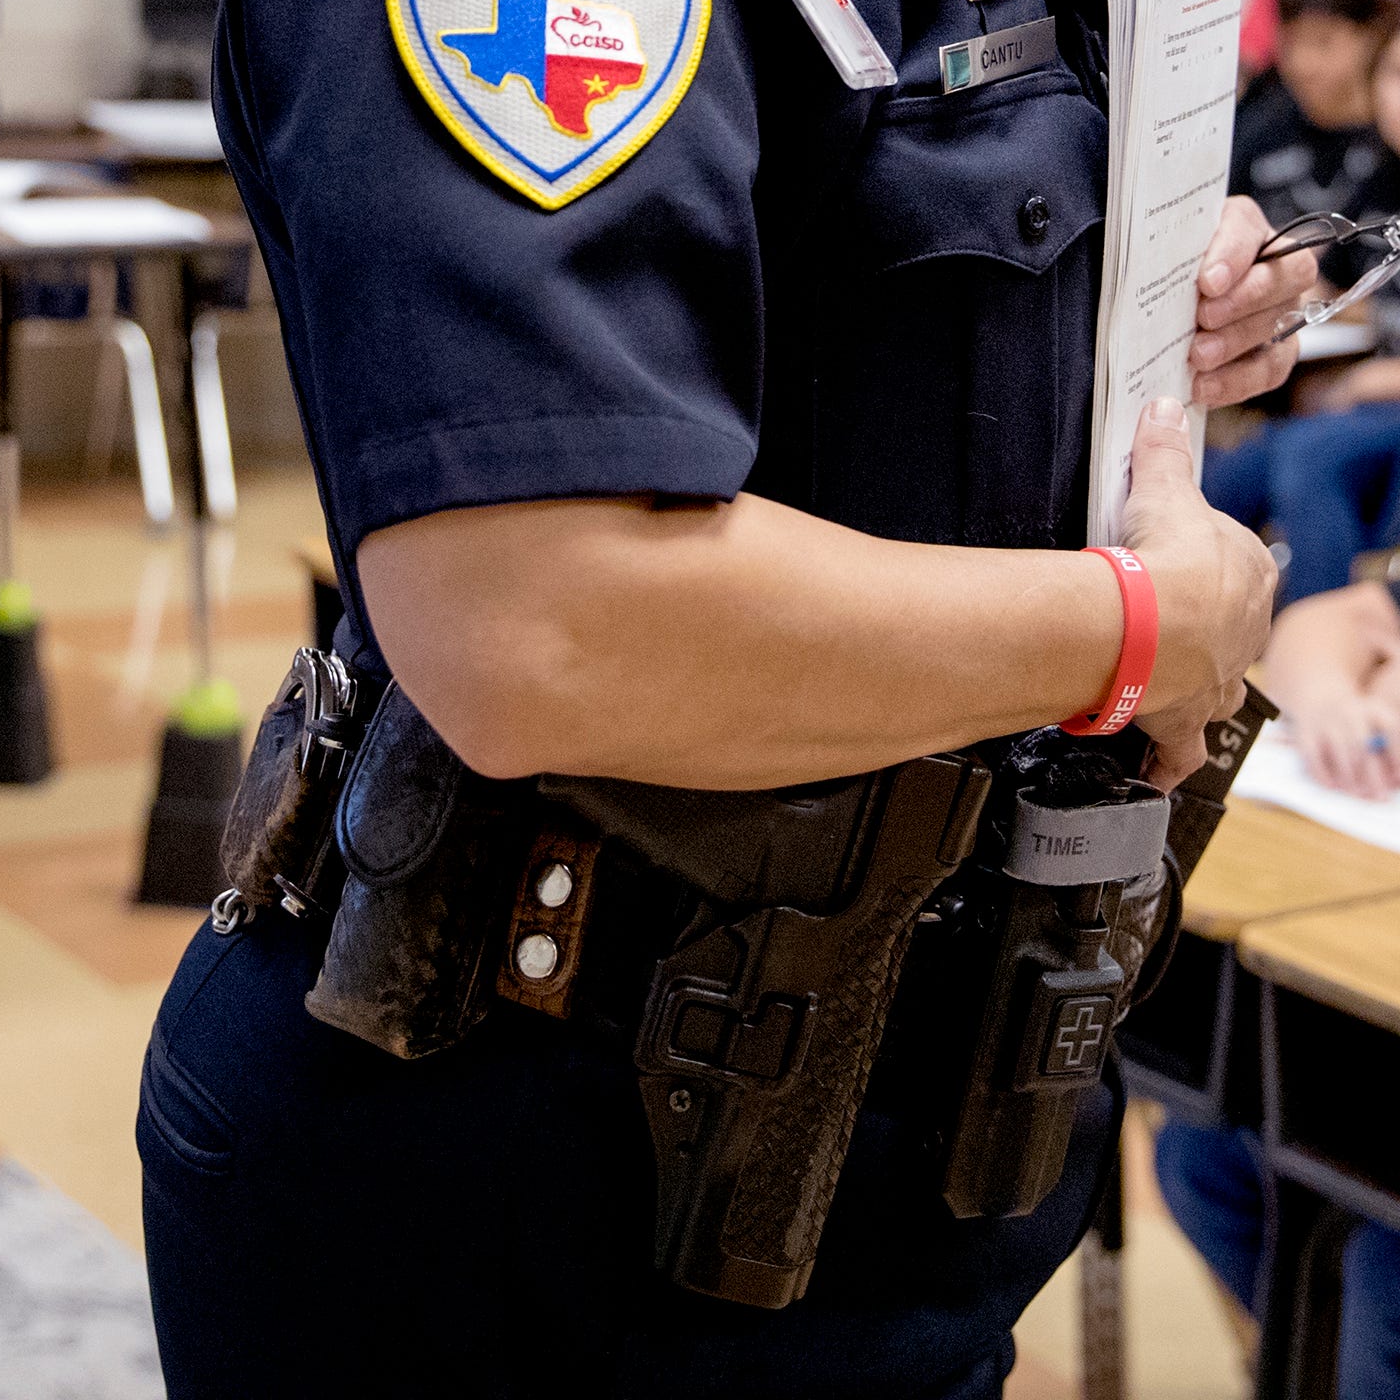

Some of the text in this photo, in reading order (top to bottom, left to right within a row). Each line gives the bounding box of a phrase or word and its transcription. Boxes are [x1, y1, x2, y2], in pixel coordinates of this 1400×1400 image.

[981, 40, 1024, 70] CANTU
[1106, 546, 1143, 572] DR
[1100, 684, 1143, 731] FREE
[1032, 832, 1090, 856] TIME:
